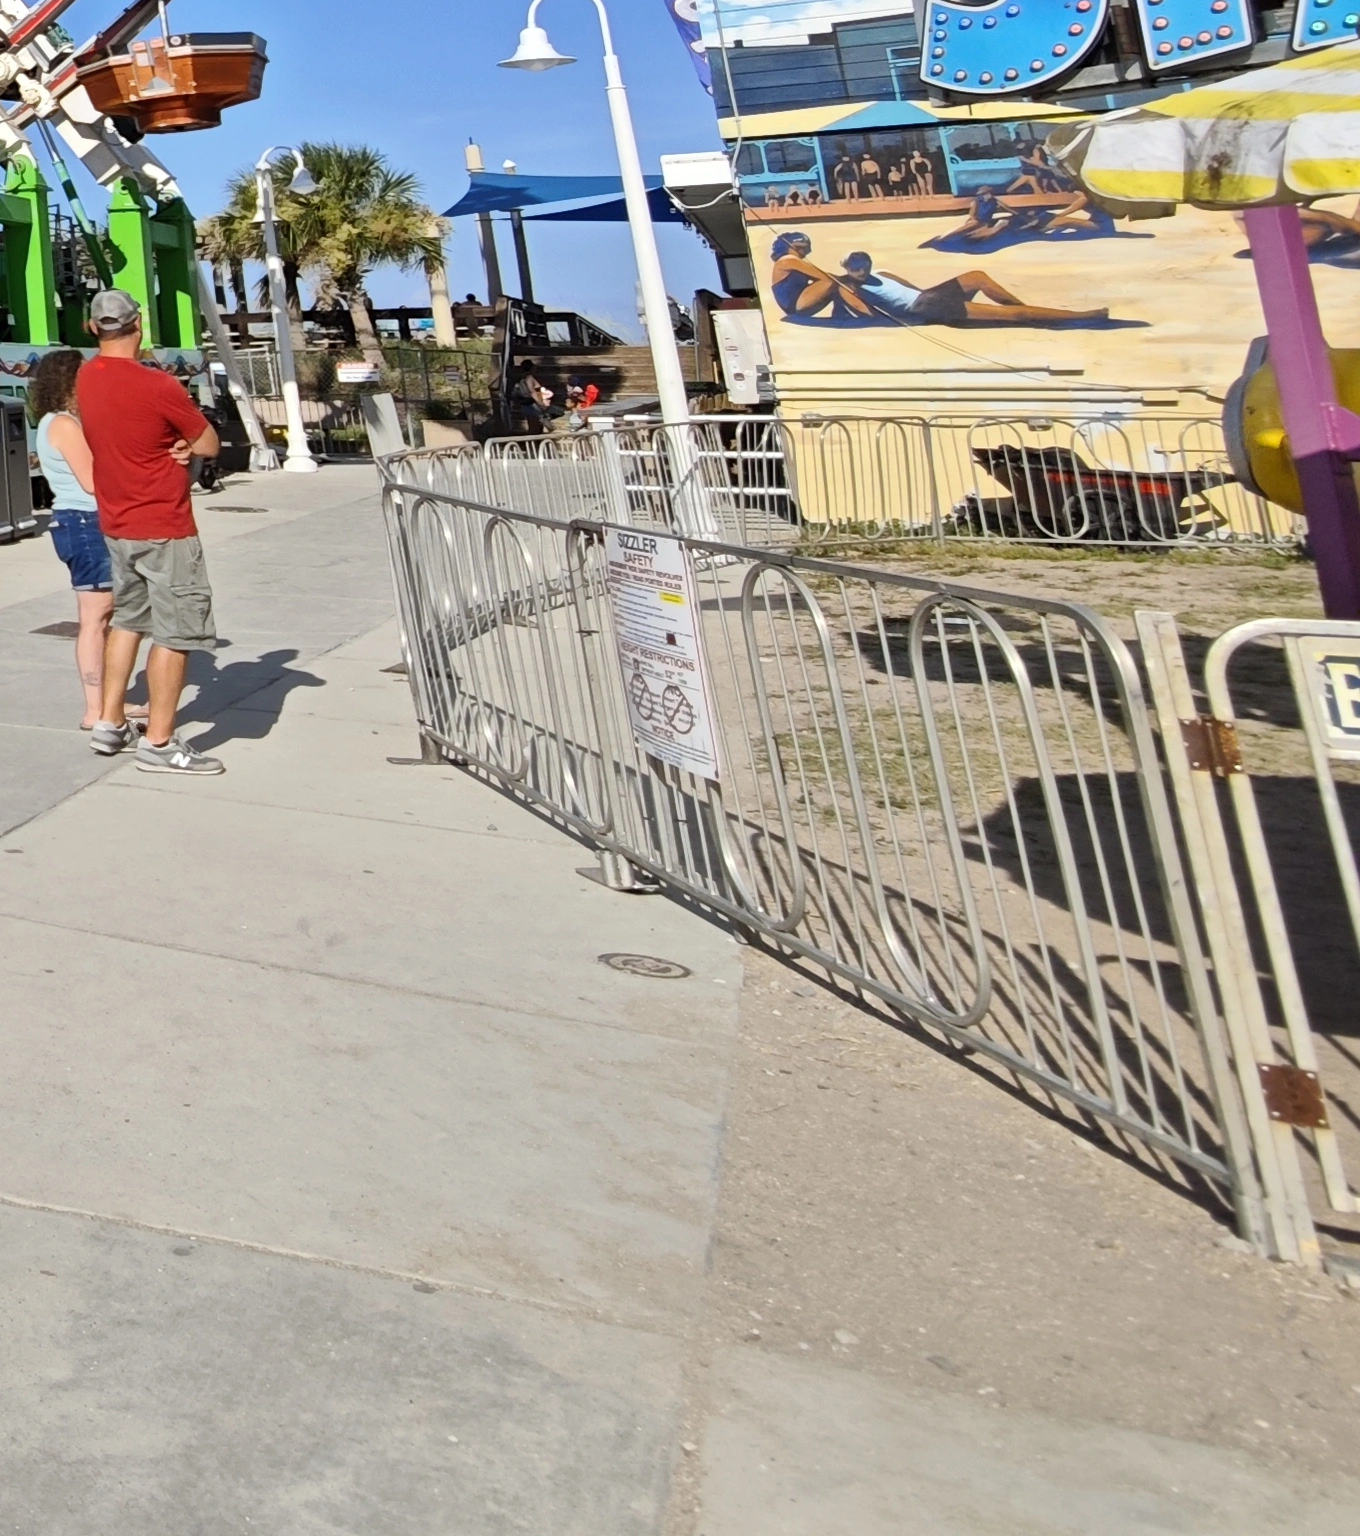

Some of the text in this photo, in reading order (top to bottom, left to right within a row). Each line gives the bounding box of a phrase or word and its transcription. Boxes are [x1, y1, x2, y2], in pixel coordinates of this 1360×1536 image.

[617, 533, 659, 555] SIZZLER
[623, 551, 654, 568] SAFETY
[639, 647, 696, 672] RESTRICTIONS
[169, 751, 191, 768] N
